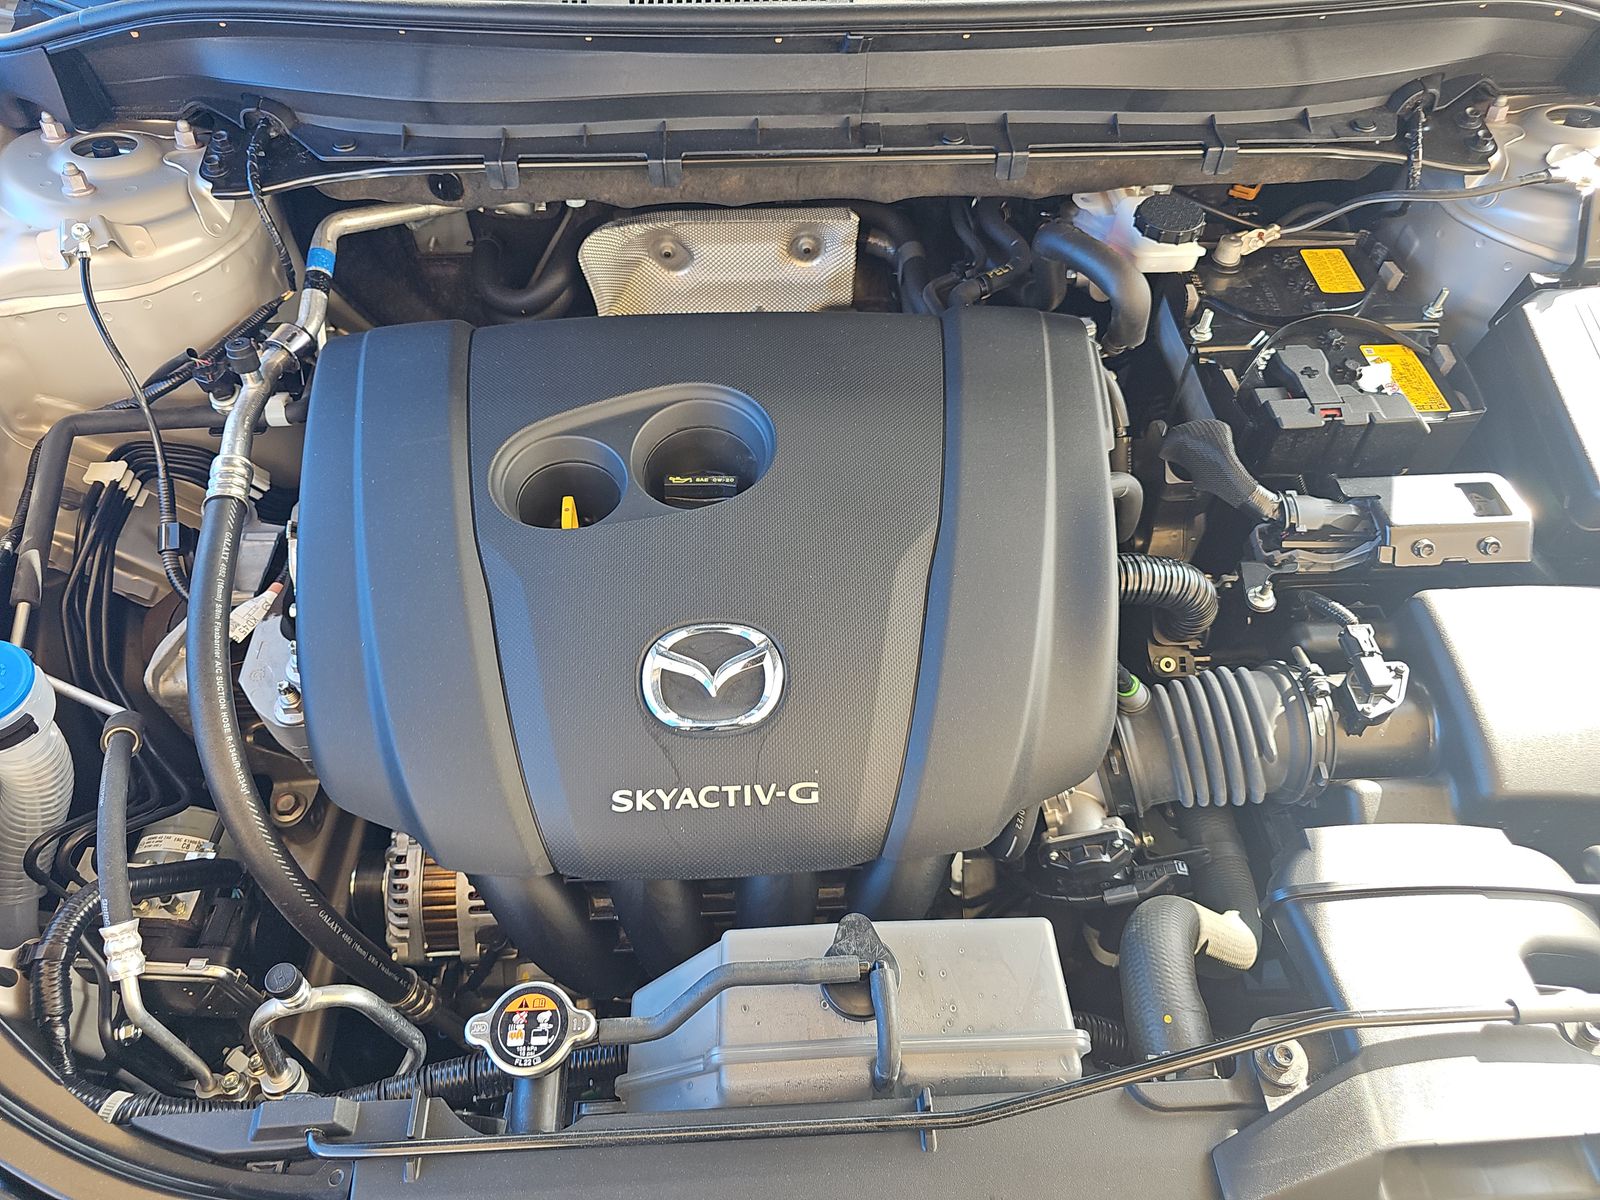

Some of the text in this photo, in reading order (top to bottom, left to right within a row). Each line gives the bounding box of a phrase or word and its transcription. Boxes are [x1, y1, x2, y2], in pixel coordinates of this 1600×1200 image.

[221, 531, 233, 563] GALAXY
[213, 621, 222, 659] Flexbarrier
[214, 660, 223, 674] A/C
[215, 676, 227, 710] SUCTION
[220, 711, 232, 734] HOSE
[611, 782, 819, 813] SKYACTIV-G
[318, 909, 343, 935] GALAXY
[572, 1017, 586, 1031] 1.1
[514, 1058, 532, 1067] FL22
